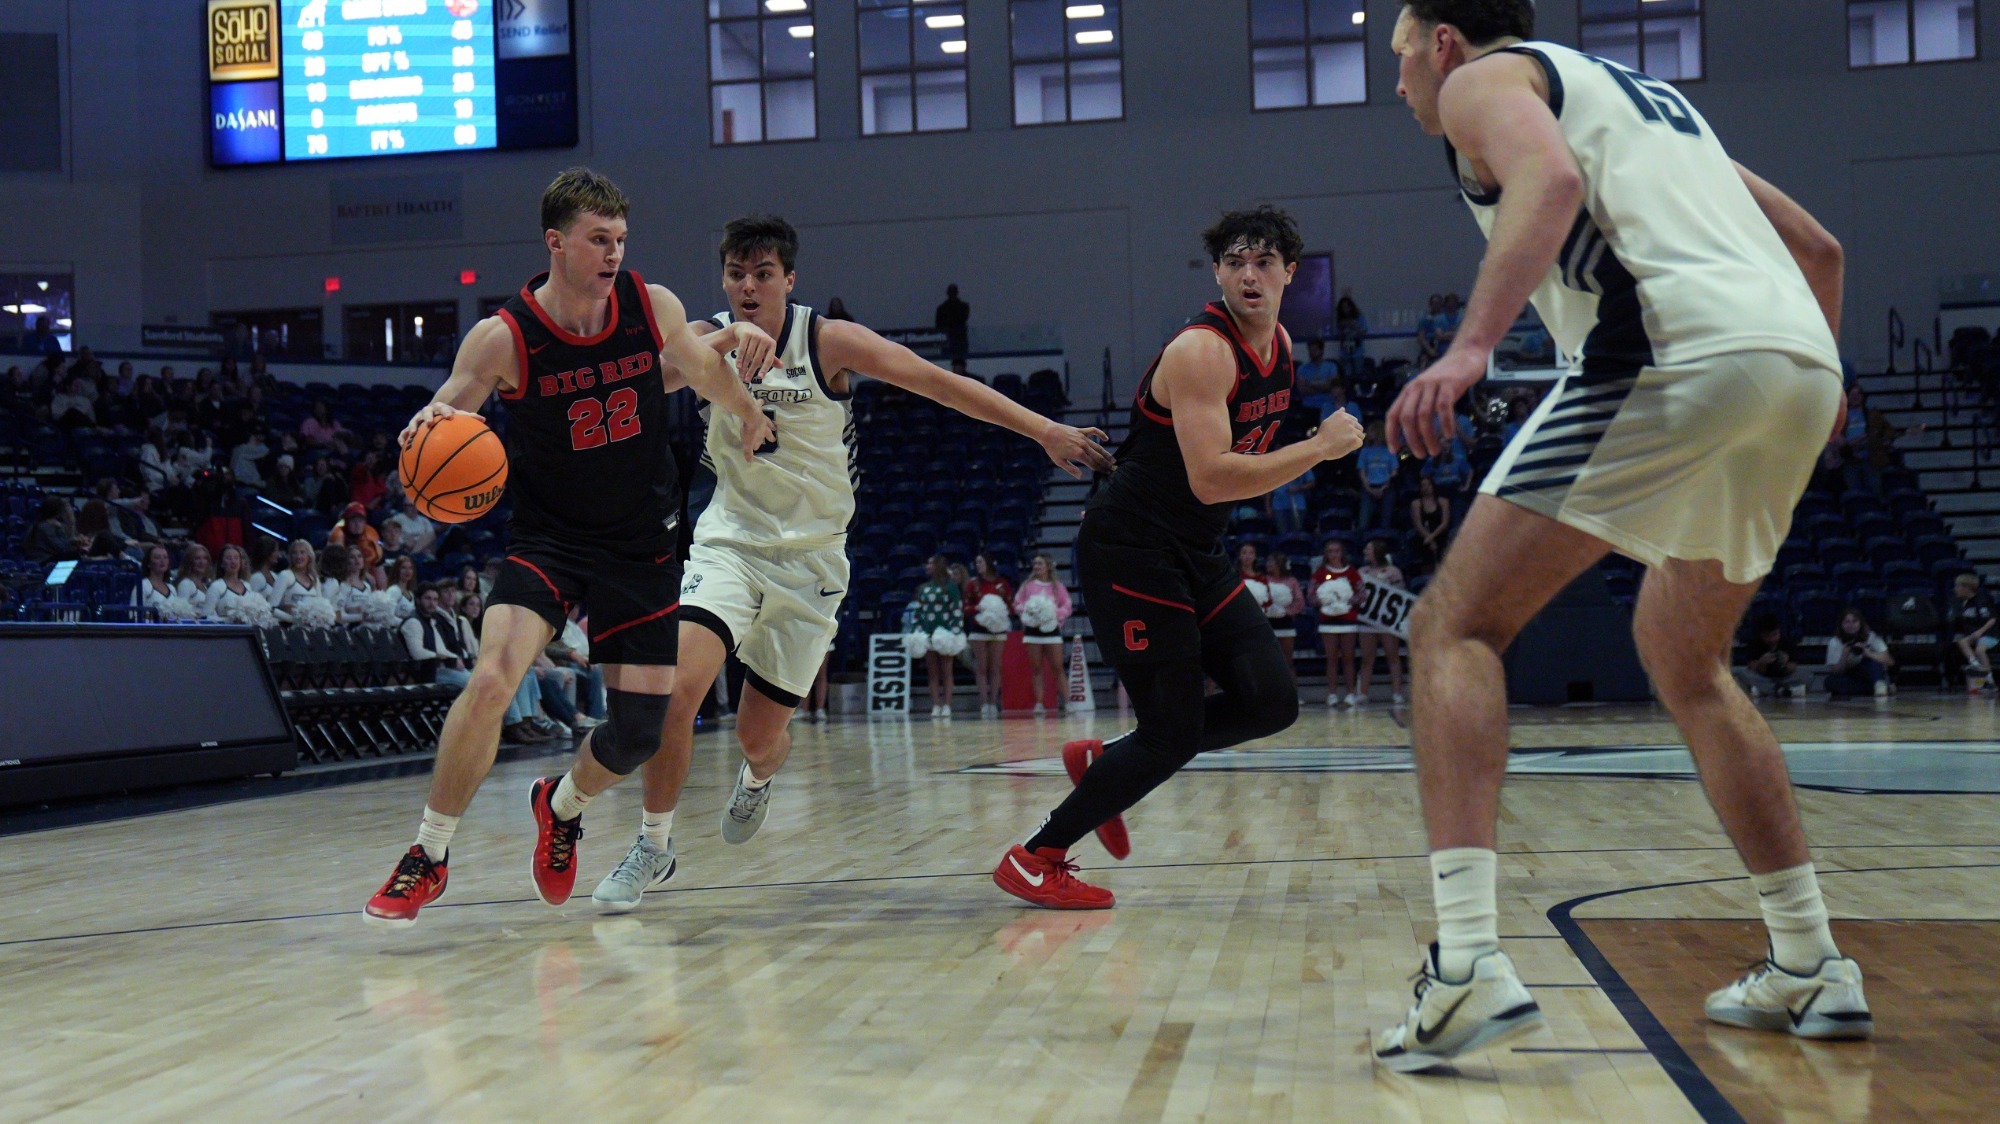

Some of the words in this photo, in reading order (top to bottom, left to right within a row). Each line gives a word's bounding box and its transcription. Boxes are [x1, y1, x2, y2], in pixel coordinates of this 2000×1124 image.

[499, 26, 531, 38] SEND
[215, 43, 268, 64] SOCIAL
[1574, 53, 1702, 138] 15
[215, 108, 276, 131] DASANI
[538, 367, 596, 397] BIG
[599, 351, 653, 385] RED
[753, 388, 812, 403] FORD
[1235, 397, 1267, 422] BIG
[567, 387, 642, 451] 22
[1230, 420, 1280, 455] 21
[1123, 620, 1149, 651] C
[871, 637, 907, 711] NOISE
